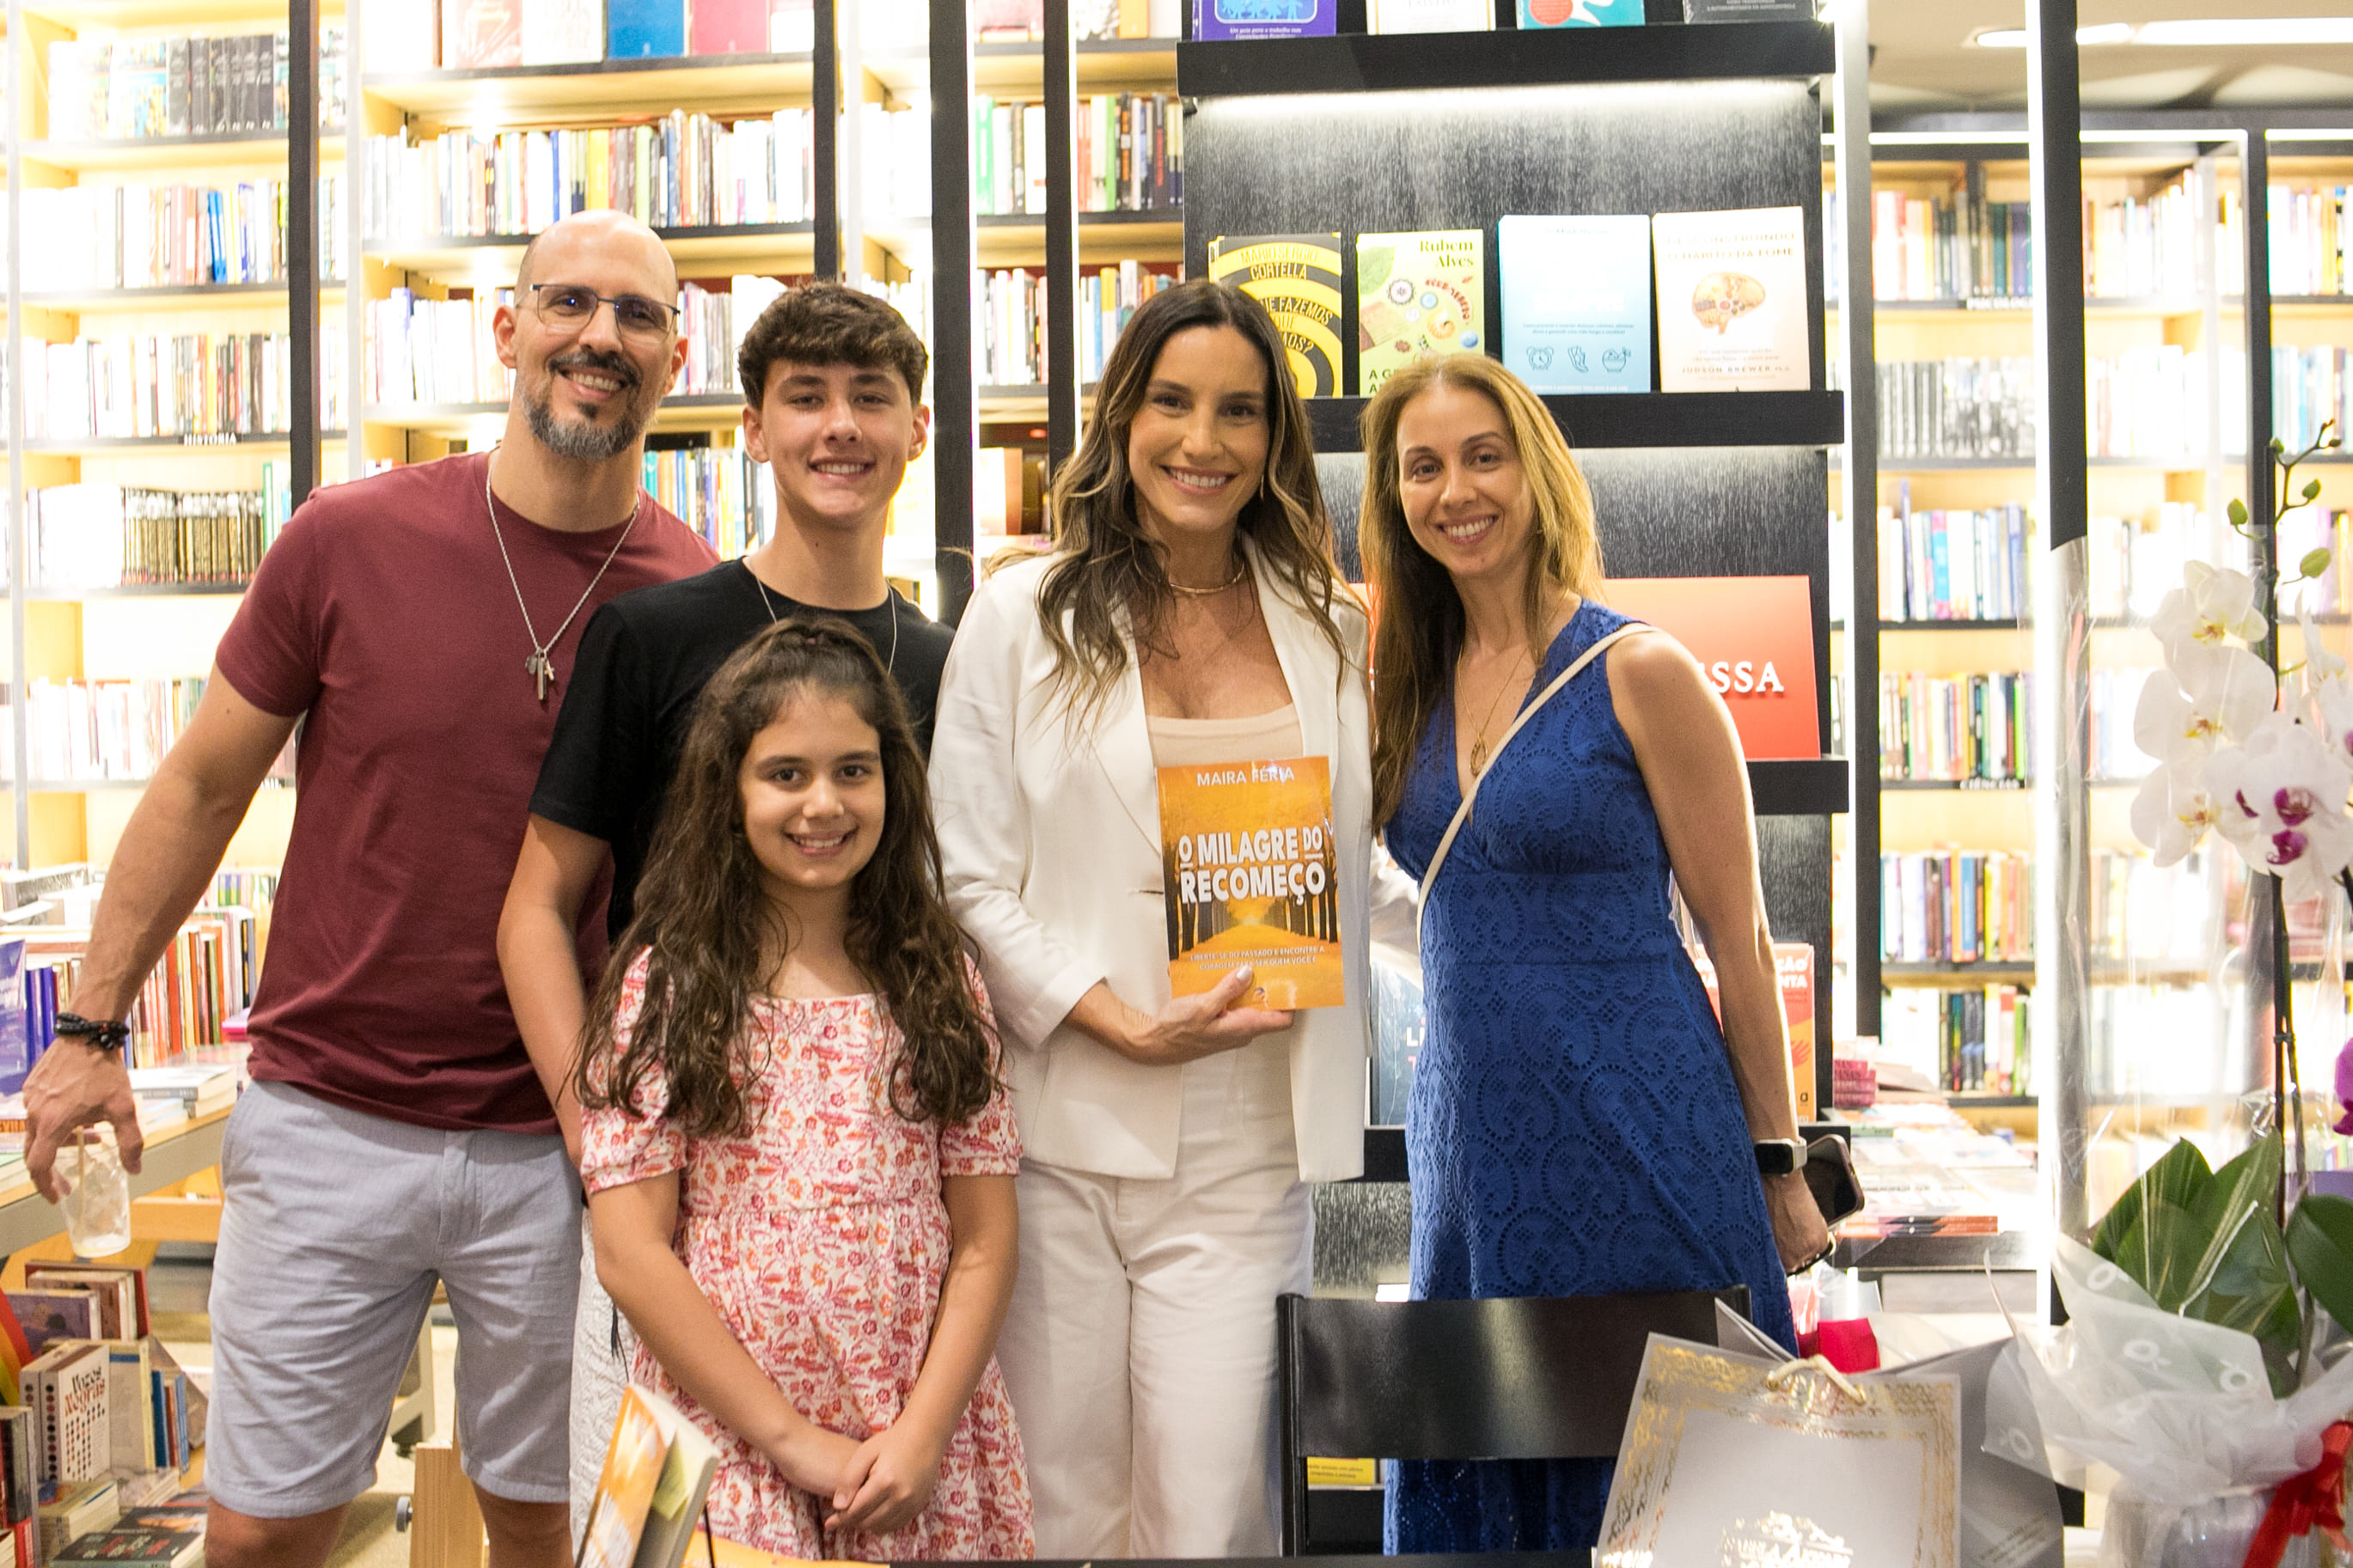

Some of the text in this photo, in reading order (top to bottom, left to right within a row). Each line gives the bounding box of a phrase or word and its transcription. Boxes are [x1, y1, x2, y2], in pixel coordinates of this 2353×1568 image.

[1420, 239, 1474, 253] Rubem
[1240, 246, 1275, 265] MARIO
[1435, 254, 1475, 268] Alves
[1250, 262, 1307, 280] CORTELLA
[1280, 296, 1333, 326] FAZEMOS
[1368, 369, 1378, 380] A
[1196, 770, 1247, 787] MAIRA
[1178, 825, 1324, 868] O MILAGRE DO
[1180, 862, 1326, 906] RECOMEÇO
[1241, 949, 1273, 958] PASSADO
[1280, 947, 1317, 955] ENCONTRE
[1269, 957, 1290, 966] QUEM
